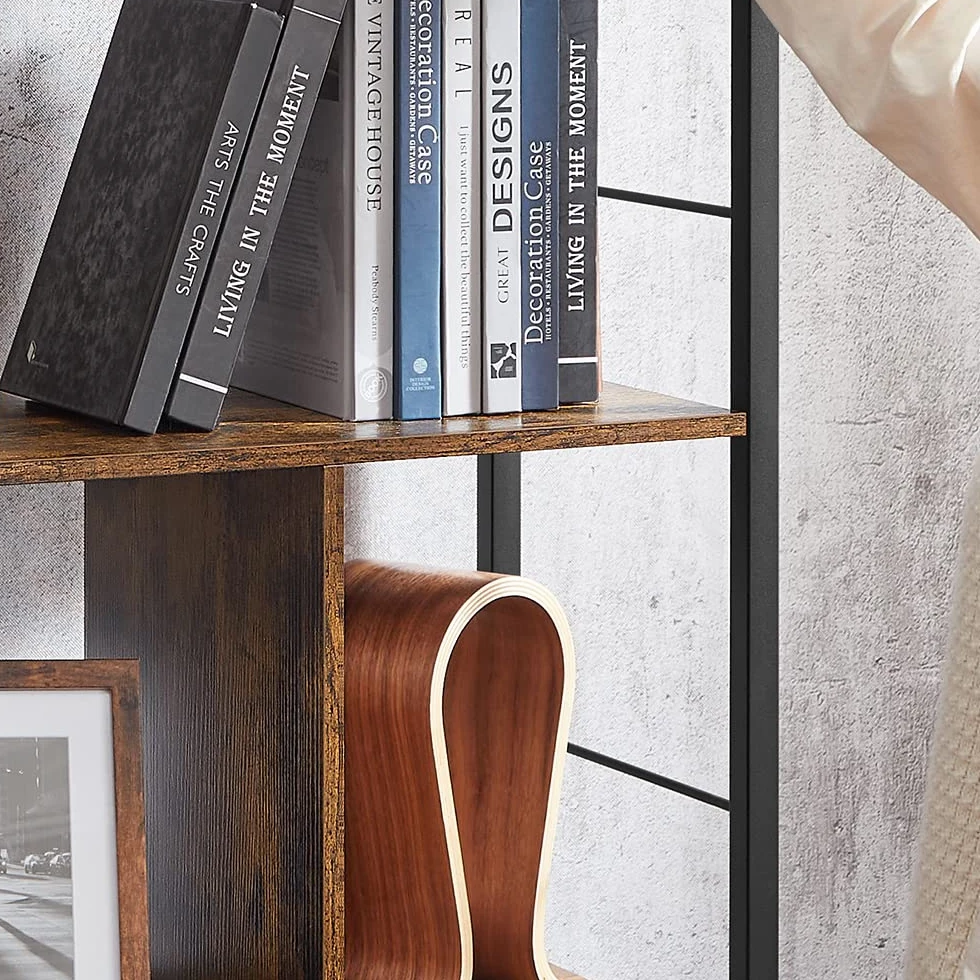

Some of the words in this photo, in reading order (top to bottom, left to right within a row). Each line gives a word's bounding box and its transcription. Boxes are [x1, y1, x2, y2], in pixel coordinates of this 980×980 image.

[367, 12, 382, 121] VINTAGE
[409, 24, 417, 85] RESTAURANTS
[266, 64, 310, 165] MOMENT
[569, 39, 587, 137] MOMENT
[214, 120, 240, 171] ARTS
[366, 126, 382, 211] HOUSE
[417, 124, 438, 185] Case
[458, 132, 469, 155] just
[491, 61, 513, 232] DESIGNS
[569, 146, 586, 193] THE
[249, 170, 279, 216] THE
[460, 159, 468, 188] want
[523, 140, 544, 201] Case
[199, 179, 225, 217] THE
[460, 192, 468, 204] to
[568, 203, 585, 225] IN
[239, 225, 262, 252] IN
[460, 207, 470, 246] collect
[176, 224, 209, 296] CRAFTS
[370, 264, 380, 303] Peabody
[460, 250, 470, 269] the
[497, 247, 509, 304] GREAT
[524, 206, 544, 345] Decoration
[565, 235, 585, 312] LIVING
[212, 259, 252, 338] LIVING
[371, 306, 380, 340] Stearns
[460, 272, 471, 327] beautiful
[459, 330, 471, 369] things
